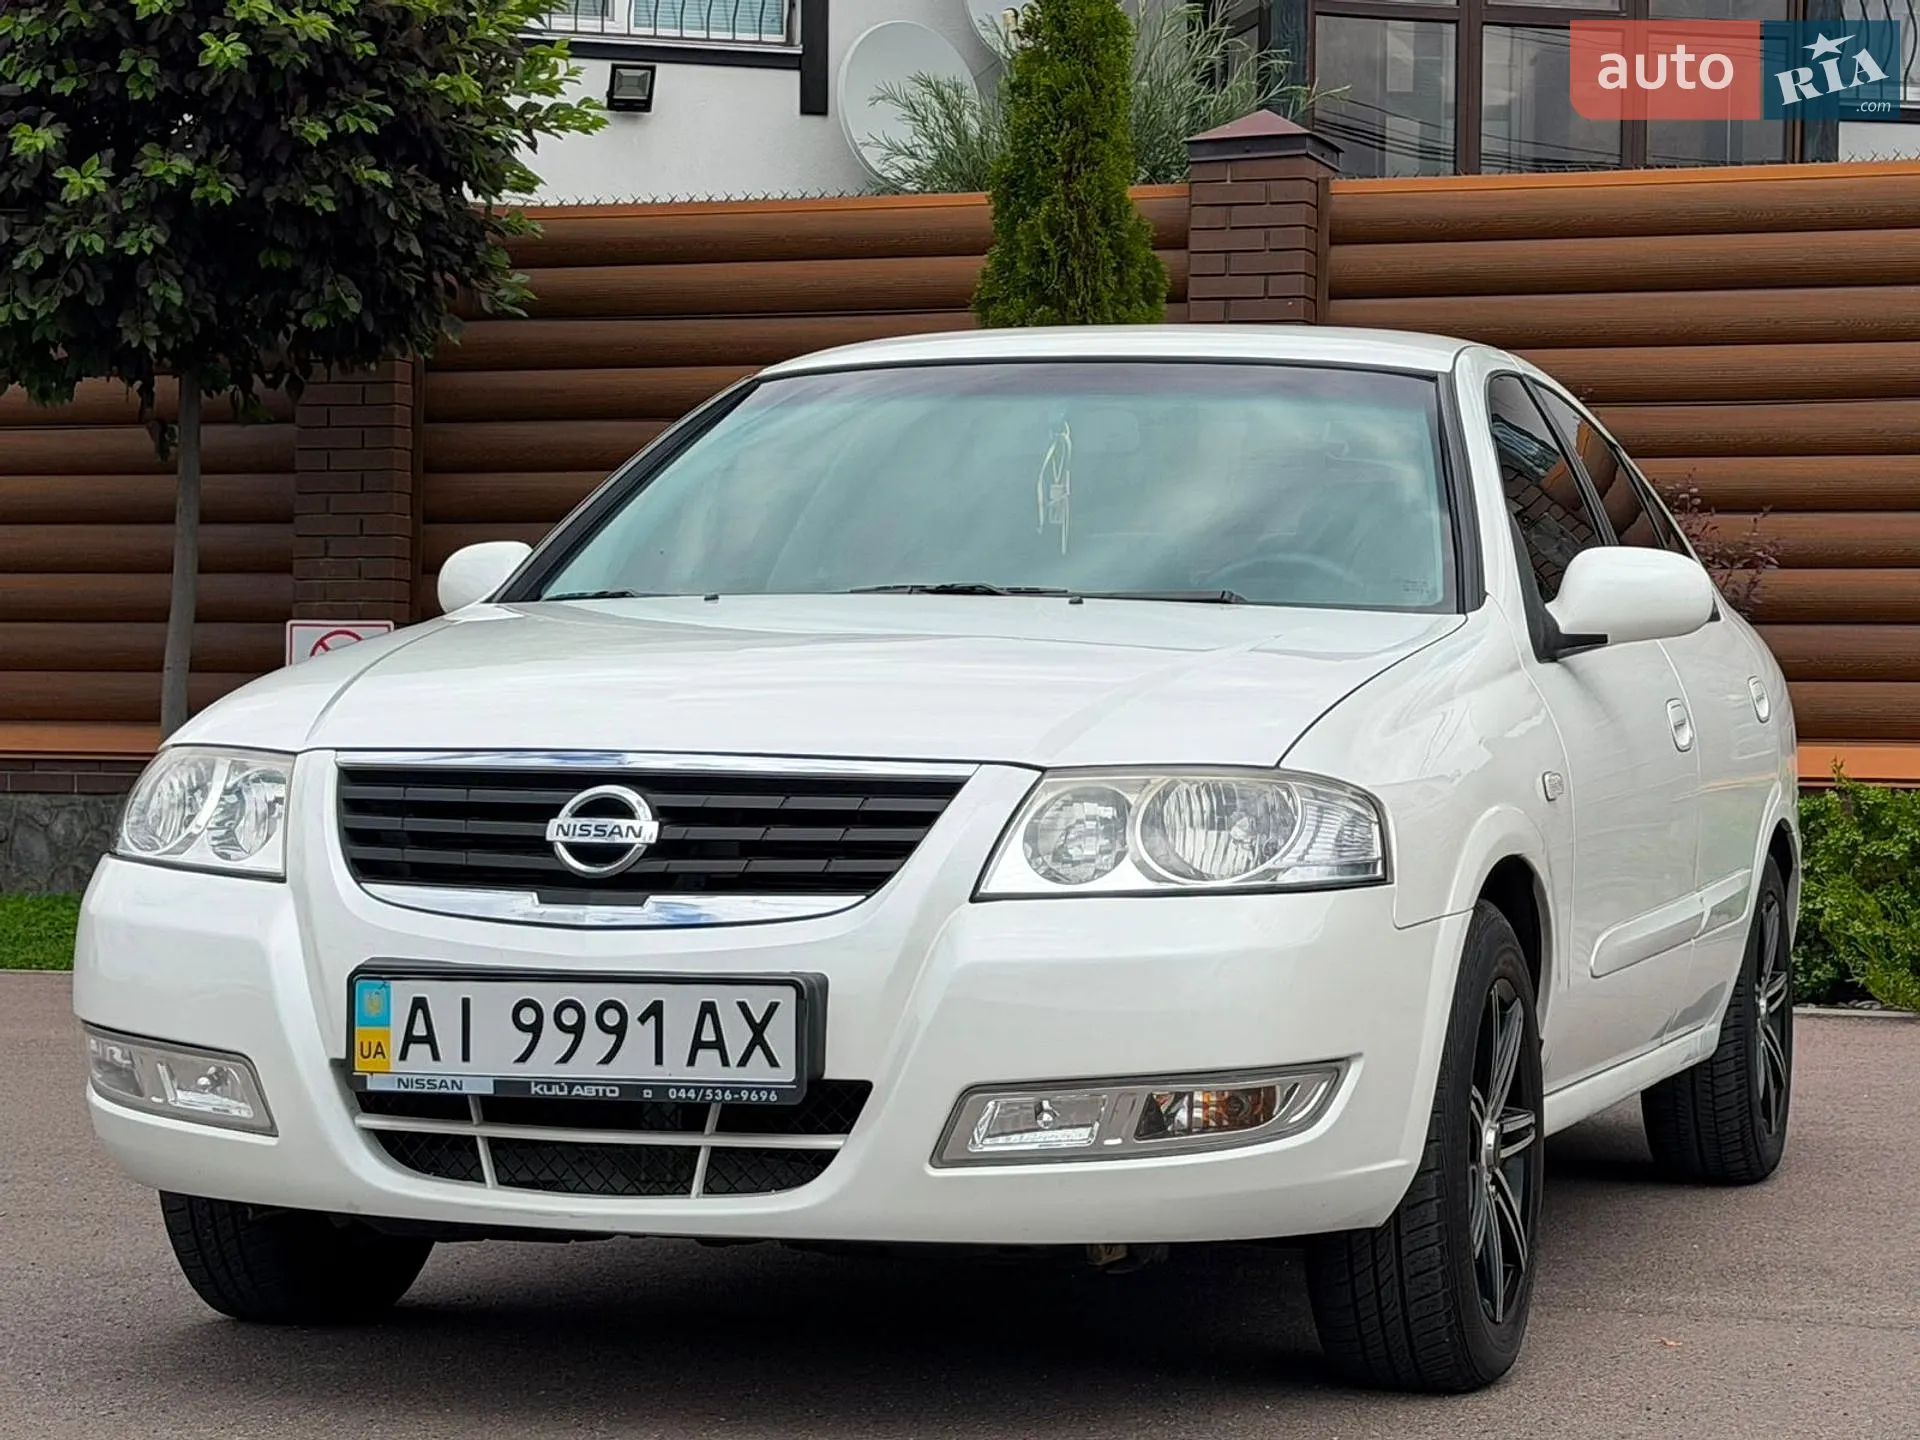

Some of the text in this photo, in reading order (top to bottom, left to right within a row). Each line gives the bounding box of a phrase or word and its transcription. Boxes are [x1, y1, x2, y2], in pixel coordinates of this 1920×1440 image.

[555, 823, 643, 839] NISSAN
[398, 996, 782, 1068] AI 9991 AX
[359, 1040, 387, 1060] UA
[397, 1077, 464, 1091] NISSAN
[668, 1088, 778, 1101] 044/536-9696
